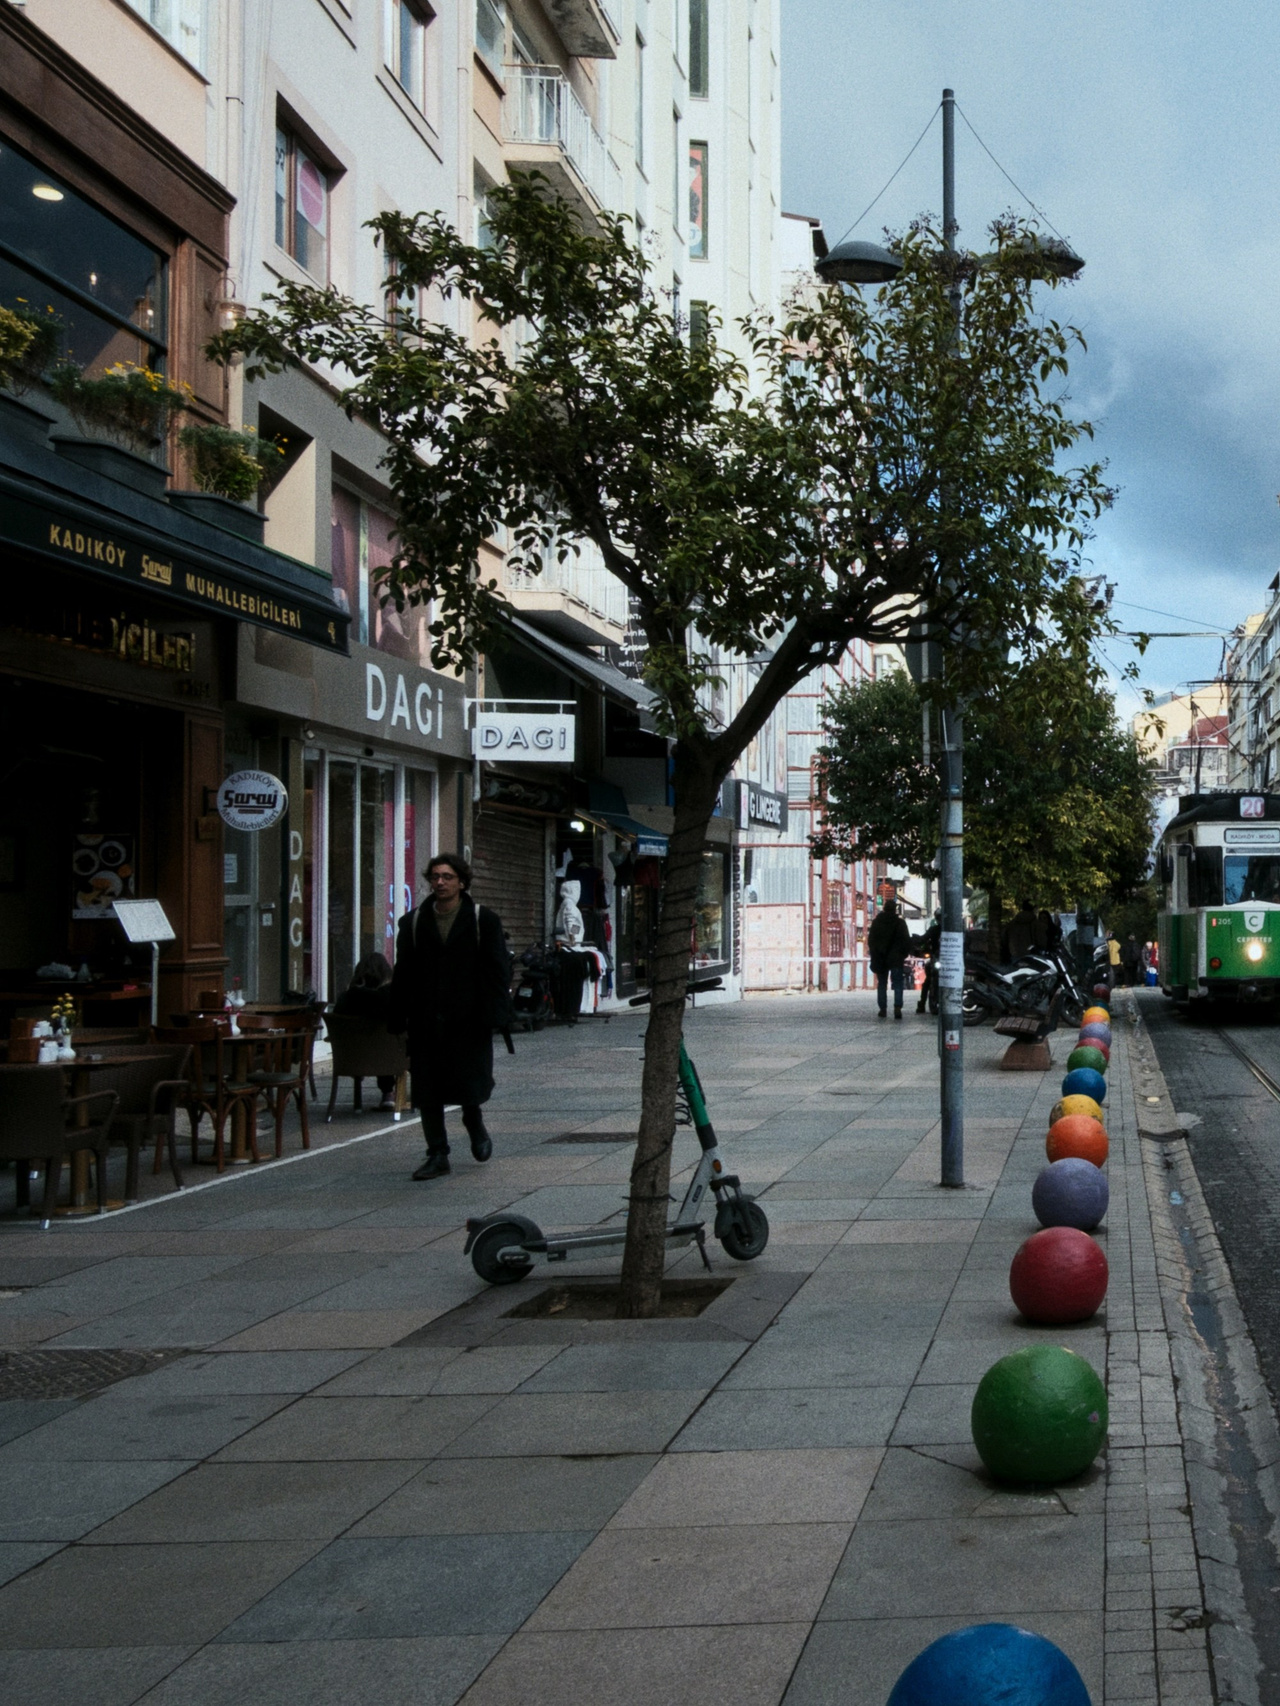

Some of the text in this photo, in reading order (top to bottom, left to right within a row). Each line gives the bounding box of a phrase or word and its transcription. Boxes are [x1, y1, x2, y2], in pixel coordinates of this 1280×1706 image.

[50, 523, 126, 568] KADIKÖY
[185, 572, 301, 629] MUHALLEBİCİLERİ
[1242, 799, 1265, 817] 20
